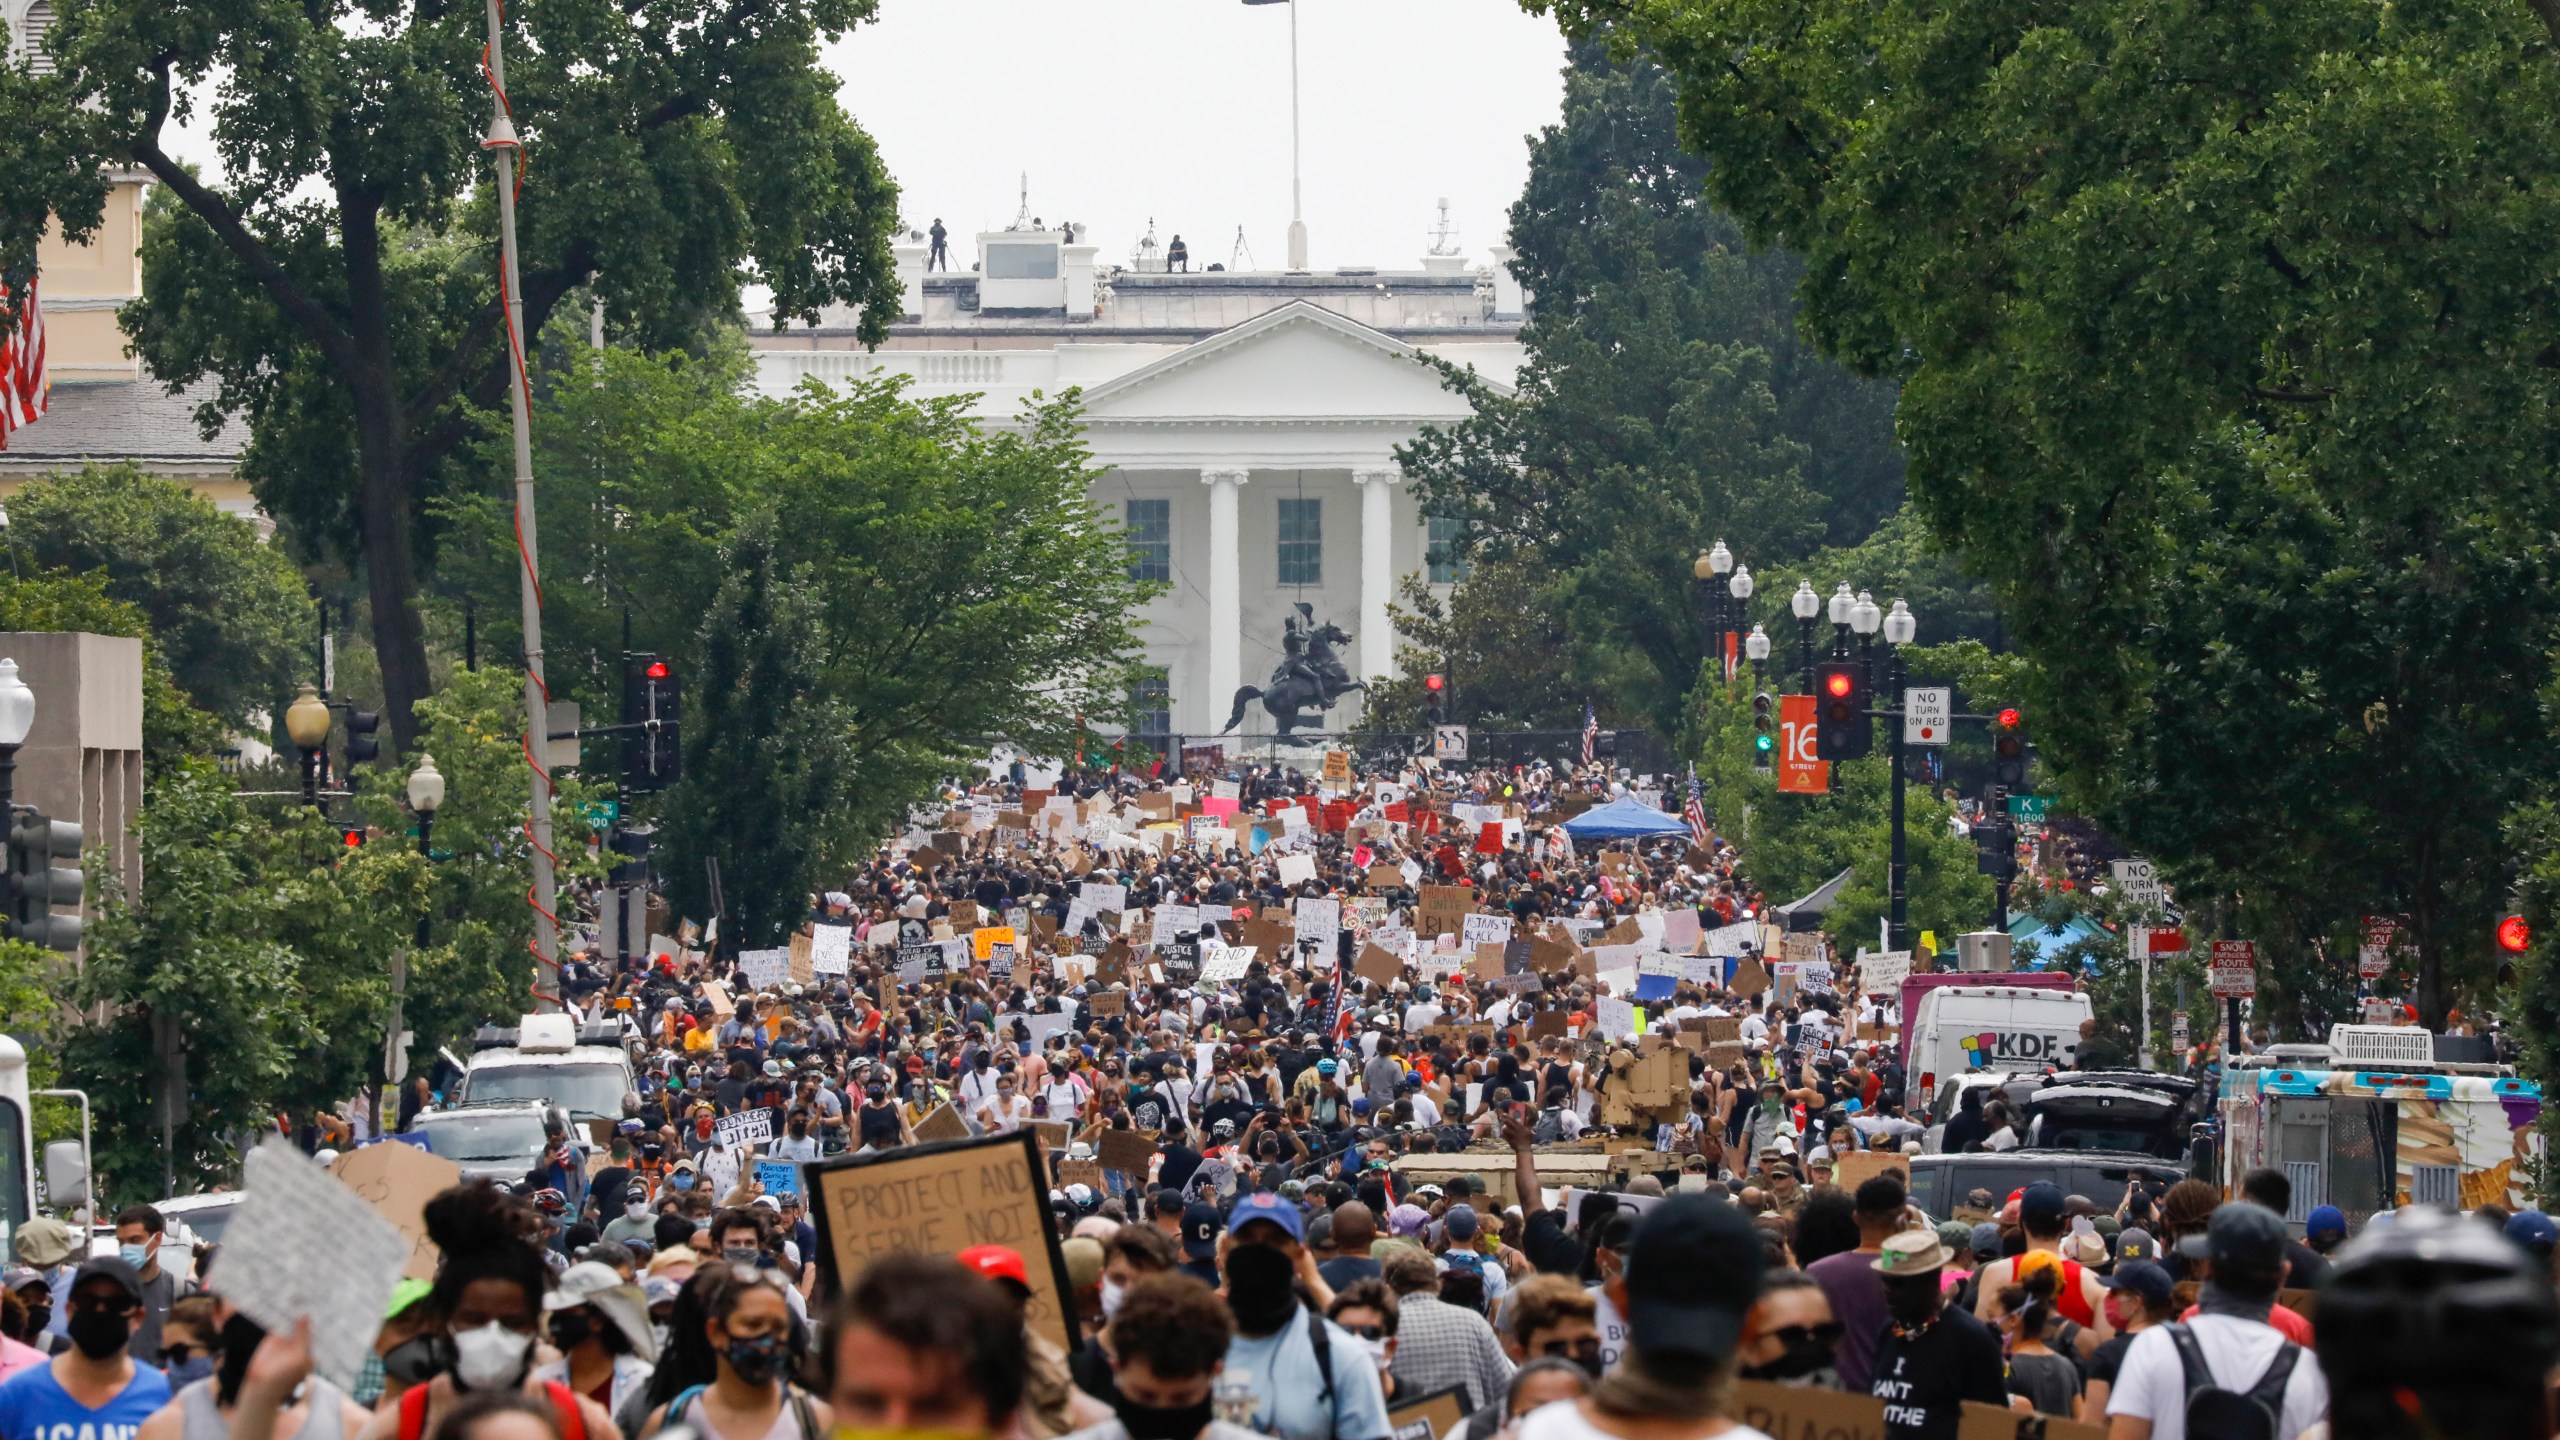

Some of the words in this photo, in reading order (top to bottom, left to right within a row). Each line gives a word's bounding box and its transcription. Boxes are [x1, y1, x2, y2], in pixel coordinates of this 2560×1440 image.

[1917, 693, 1937, 703] NO
[1914, 705, 1940, 714] TURN
[1909, 717, 1923, 726] ON
[1926, 717, 1945, 726] RED
[2022, 799, 2032, 811] K
[2018, 813, 2046, 823] 1600
[2128, 865, 2149, 877] NO
[2124, 880, 2154, 889] TURN
[2138, 892, 2160, 901] RED
[1301, 900, 1337, 911] LATINOS
[1303, 914, 1328, 922] BLACK
[1303, 923, 1328, 933] LIVES
[1501, 919, 1508, 930] 4
[1464, 930, 1494, 942] BLACK
[1161, 945, 1192, 955] JUSTICE
[2220, 943, 2246, 951] SNOW
[815, 949, 845, 959] EXPECT
[1212, 948, 1247, 961] END
[2217, 959, 2249, 967] ROUTE
[1805, 967, 1831, 977] BLACK
[1803, 1026, 1827, 1040] BLACK
[1998, 1033, 2058, 1059] KDF
[726, 1123, 770, 1145] BITCH
[760, 1163, 793, 1173] Racism
[776, 1180, 791, 1189] OF
[837, 1168, 965, 1229] PROTECT
[979, 1158, 1031, 1198] AND
[964, 1201, 1026, 1246] NOT
[1199, 1224, 1210, 1239] C
[2125, 1245, 2140, 1256] M
[1893, 1356, 1906, 1376] I
